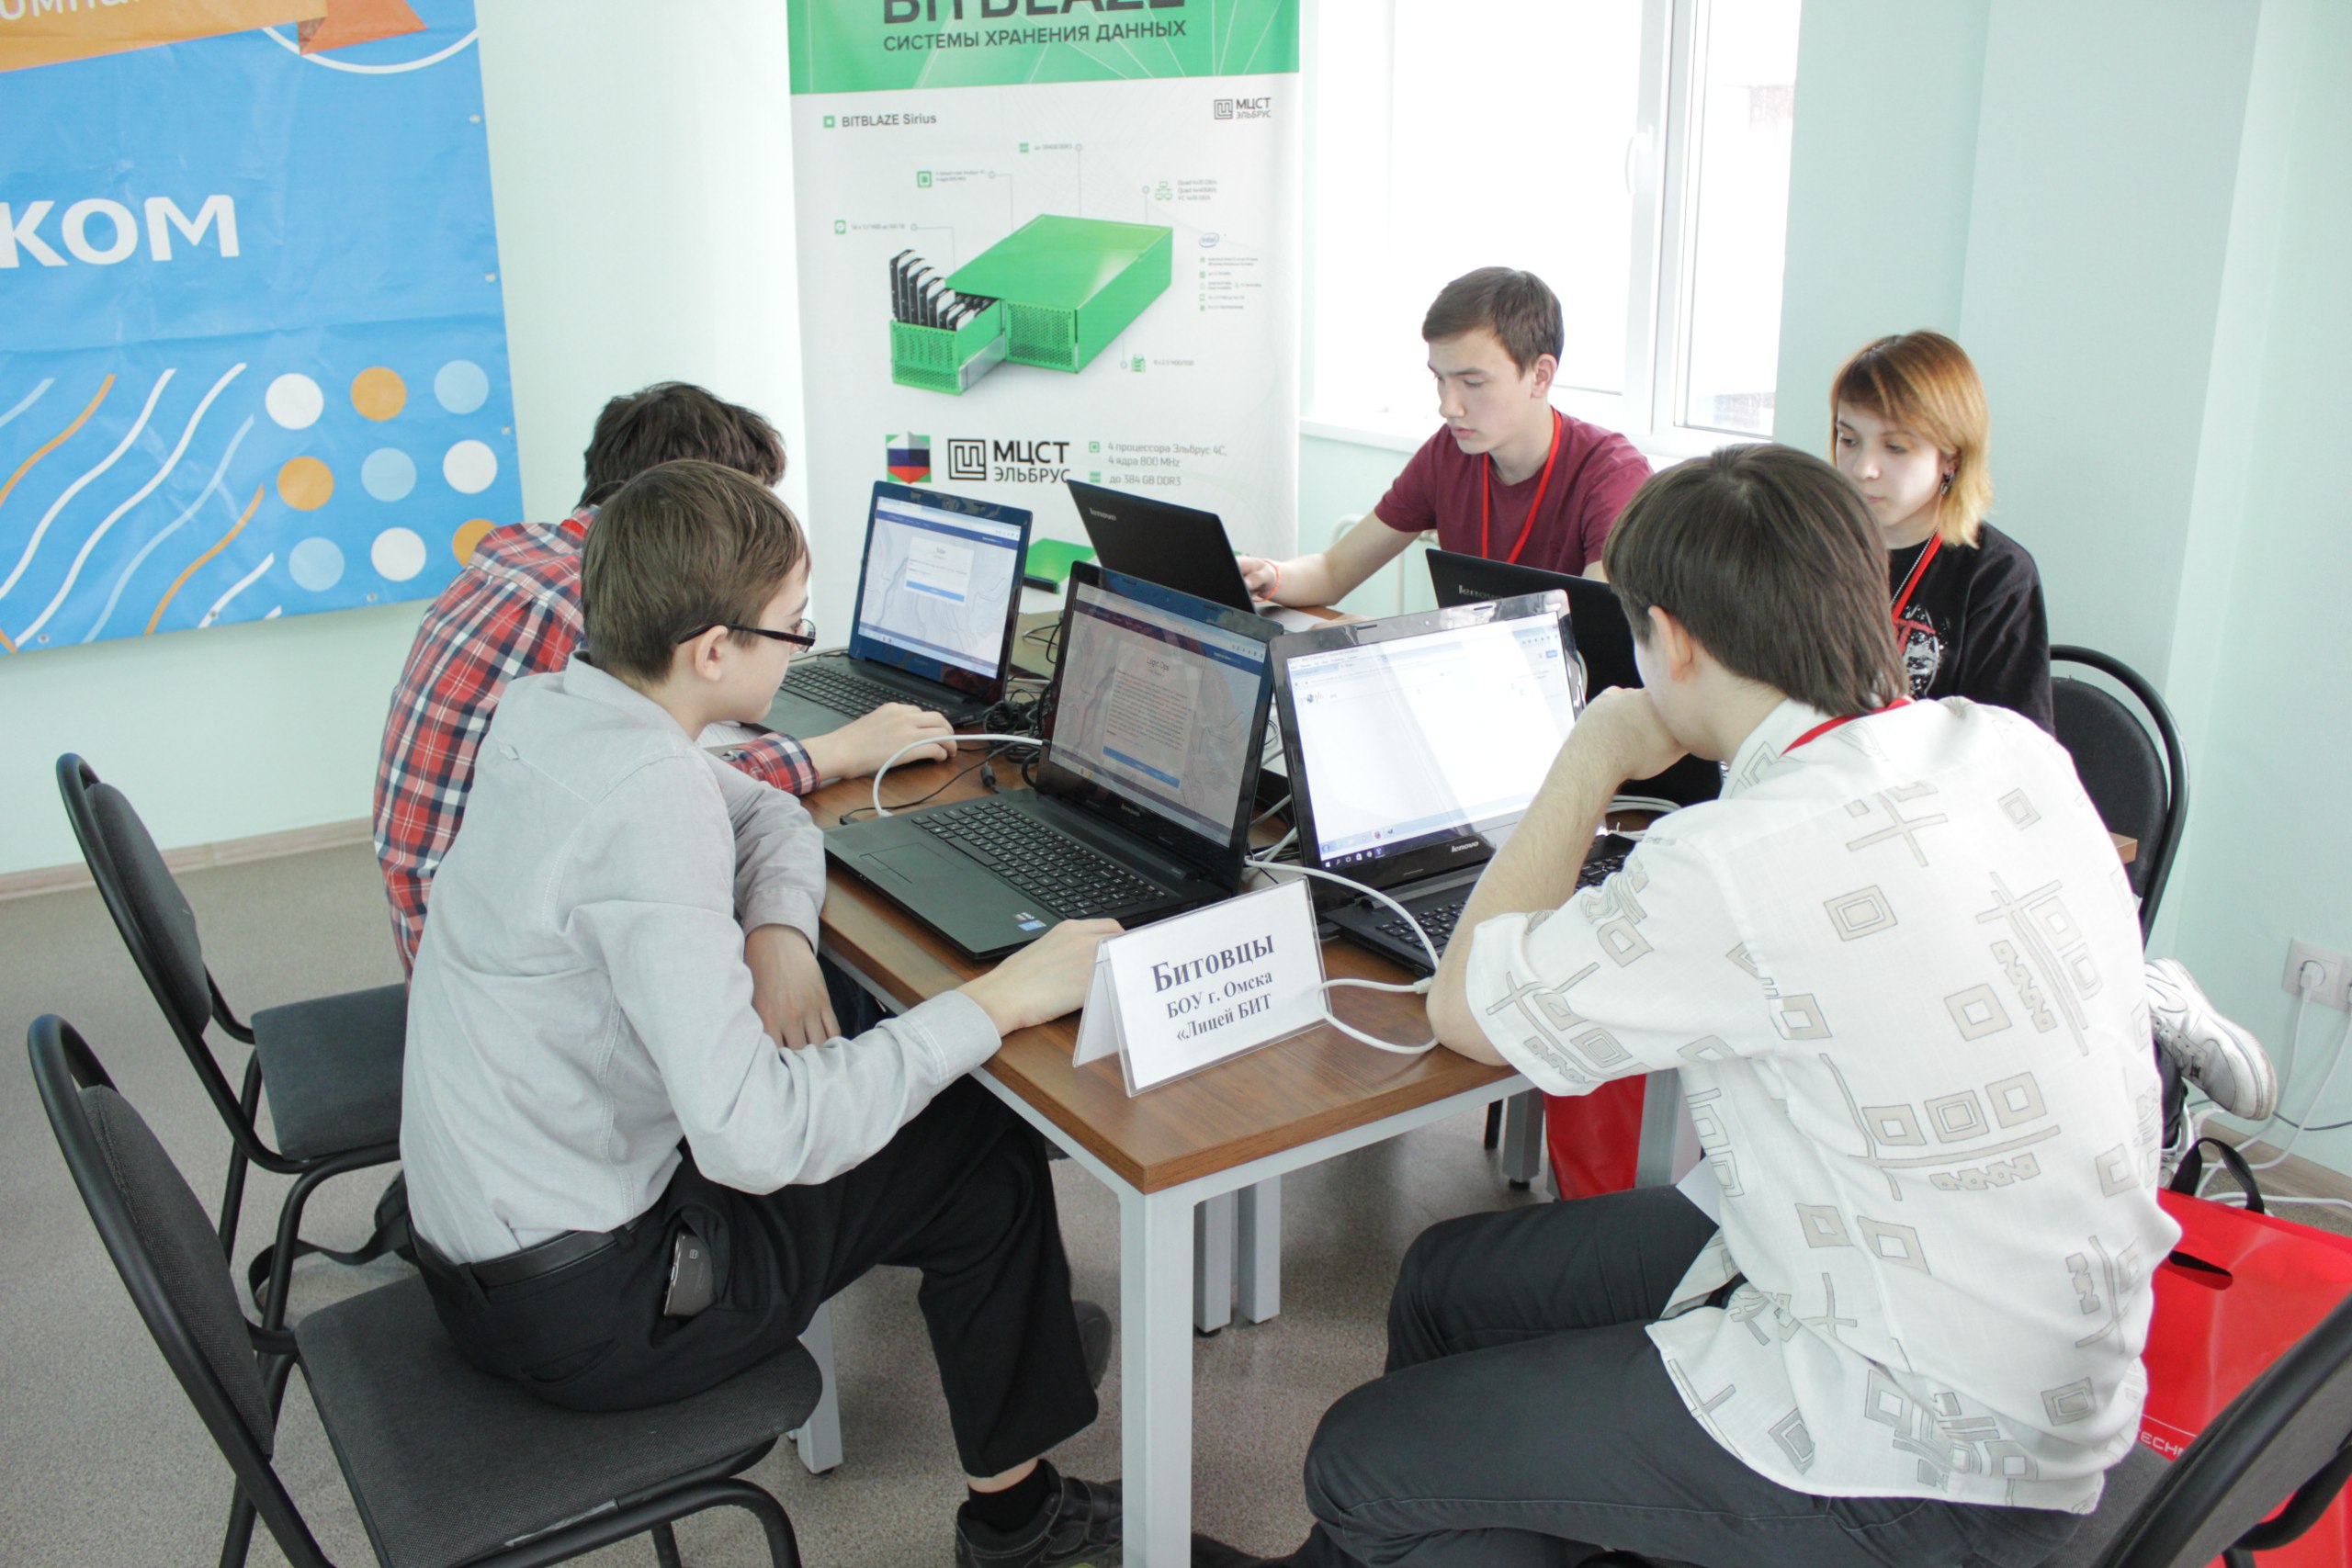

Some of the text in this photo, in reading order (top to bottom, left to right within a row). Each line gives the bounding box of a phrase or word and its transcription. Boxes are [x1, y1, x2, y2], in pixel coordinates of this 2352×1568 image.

[884, 20, 1187, 51] СИСТЕМЫ ХРАНЕНИЯ ДАННЫХ
[1236, 97, 1272, 109] МЦСТ
[842, 113, 937, 128] BITBLAZE Sirius
[993, 440, 1070, 465] МЦСТ
[1108, 442, 1114, 451] 4
[1115, 443, 1171, 455] процессора
[1172, 443, 1211, 457] Эльбрус
[1108, 456, 1181, 468] 4 ядра 800 MHz
[994, 468, 1071, 484] ЭЛЬБРУС
[1109, 475, 1182, 486] до 384 GB DDR3
[1451, 840, 1480, 853] lenovo
[1151, 934, 1275, 993] Битовцы
[1166, 972, 1273, 1020] БОУ г. Омска
[1176, 993, 1272, 1042] «Лицей БИТ
[2139, 1431, 2184, 1457] ECH
